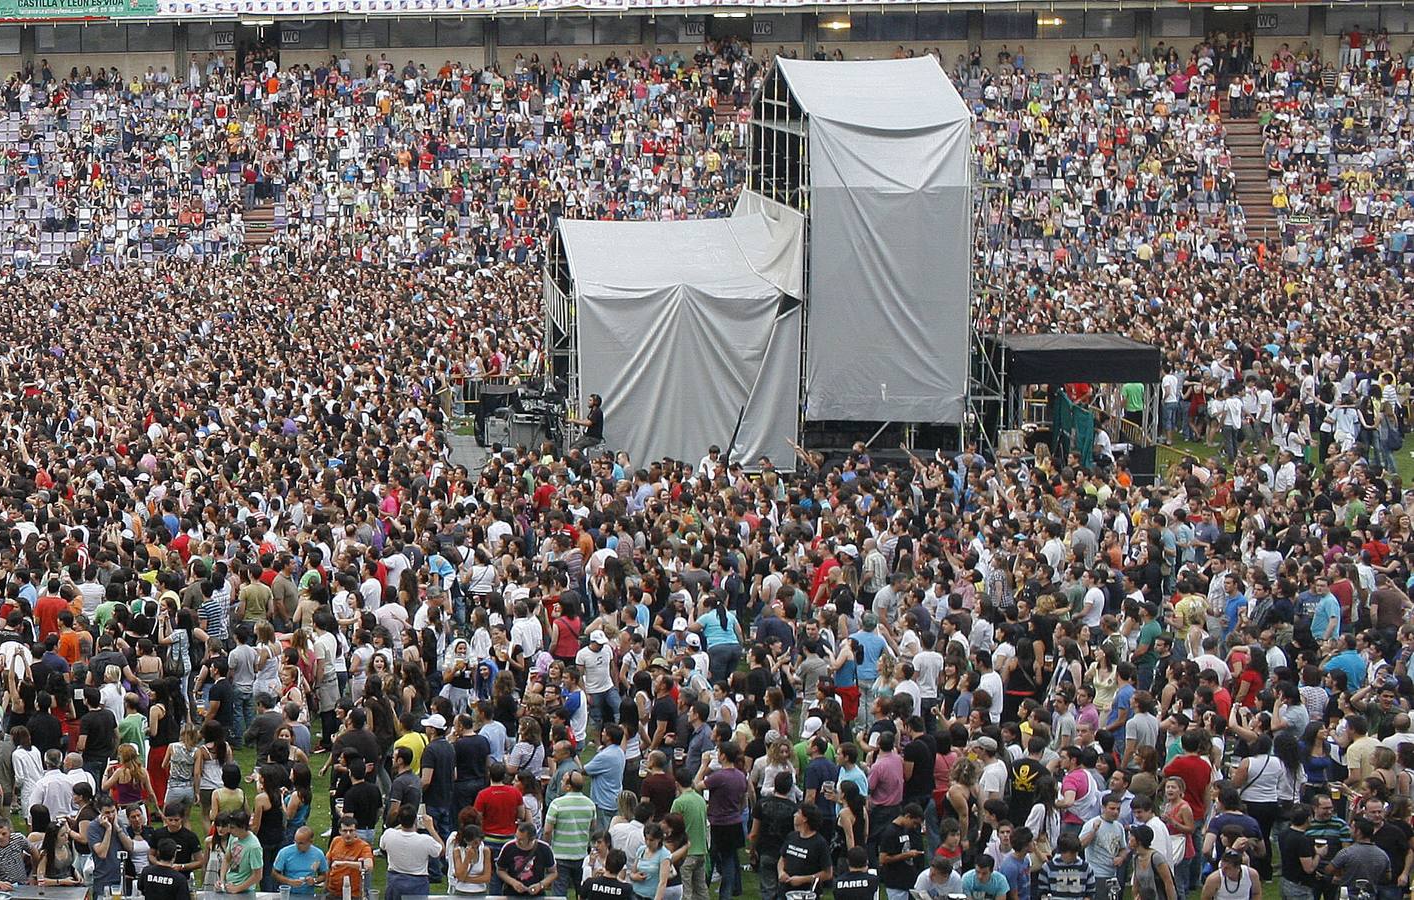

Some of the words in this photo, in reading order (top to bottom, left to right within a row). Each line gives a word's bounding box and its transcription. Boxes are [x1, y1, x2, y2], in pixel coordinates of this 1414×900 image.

[17, 0, 57, 8] CASTILLA
[1259, 16, 1276, 26] WC
[688, 23, 705, 34] WC
[755, 23, 771, 33] WC
[218, 33, 234, 43] WC
[283, 31, 299, 42] WC
[147, 874, 174, 886] BARES
[837, 880, 869, 889] BARES
[591, 883, 622, 896] BARES
